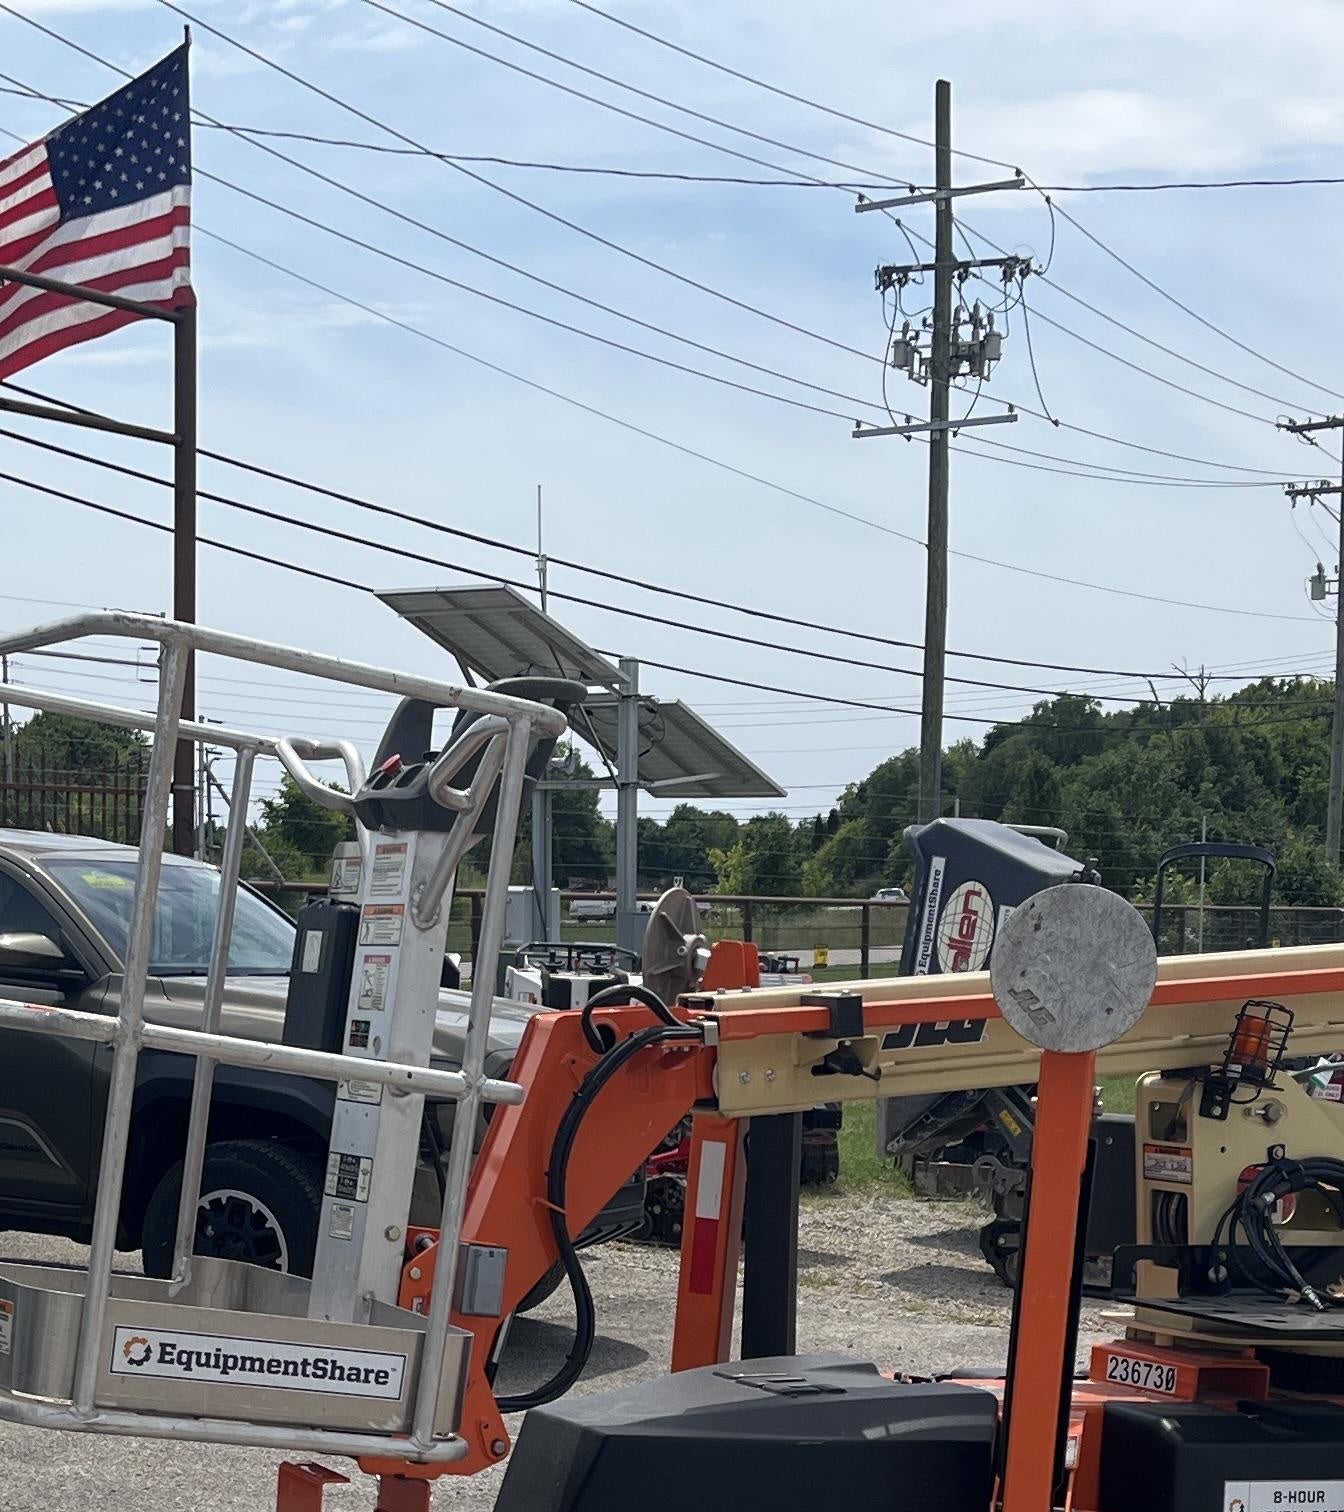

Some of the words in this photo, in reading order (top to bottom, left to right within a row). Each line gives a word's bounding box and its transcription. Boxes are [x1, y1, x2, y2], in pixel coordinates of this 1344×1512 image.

[918, 868, 942, 969] EquipmentShare
[1007, 988, 1056, 1026] JLG
[157, 1341, 390, 1386] EquipmentShare
[1108, 1356, 1176, 1392] 236730
[1273, 1490, 1326, 1504] 8-HOUR
